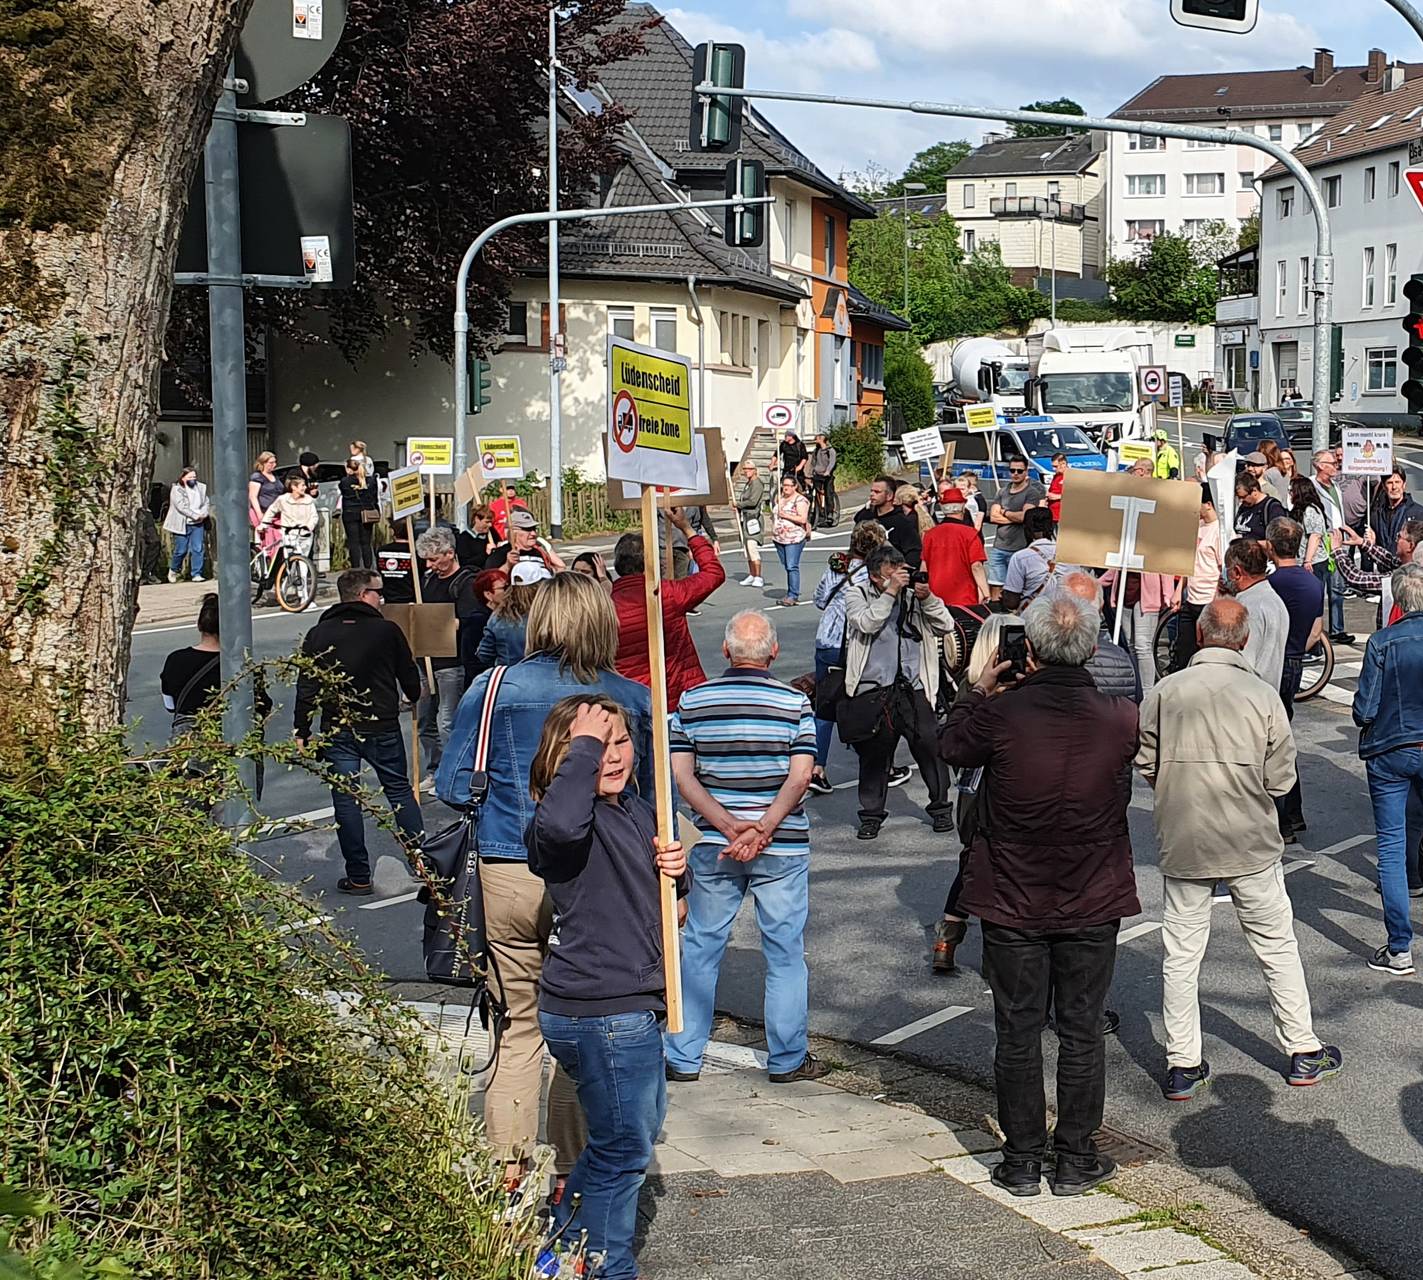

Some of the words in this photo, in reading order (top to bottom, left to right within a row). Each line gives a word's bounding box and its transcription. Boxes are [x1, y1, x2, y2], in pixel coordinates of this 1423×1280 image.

[621, 361, 681, 397] Lüdenscheid
[639, 414, 657, 434] freie
[660, 418, 680, 438] Zone
